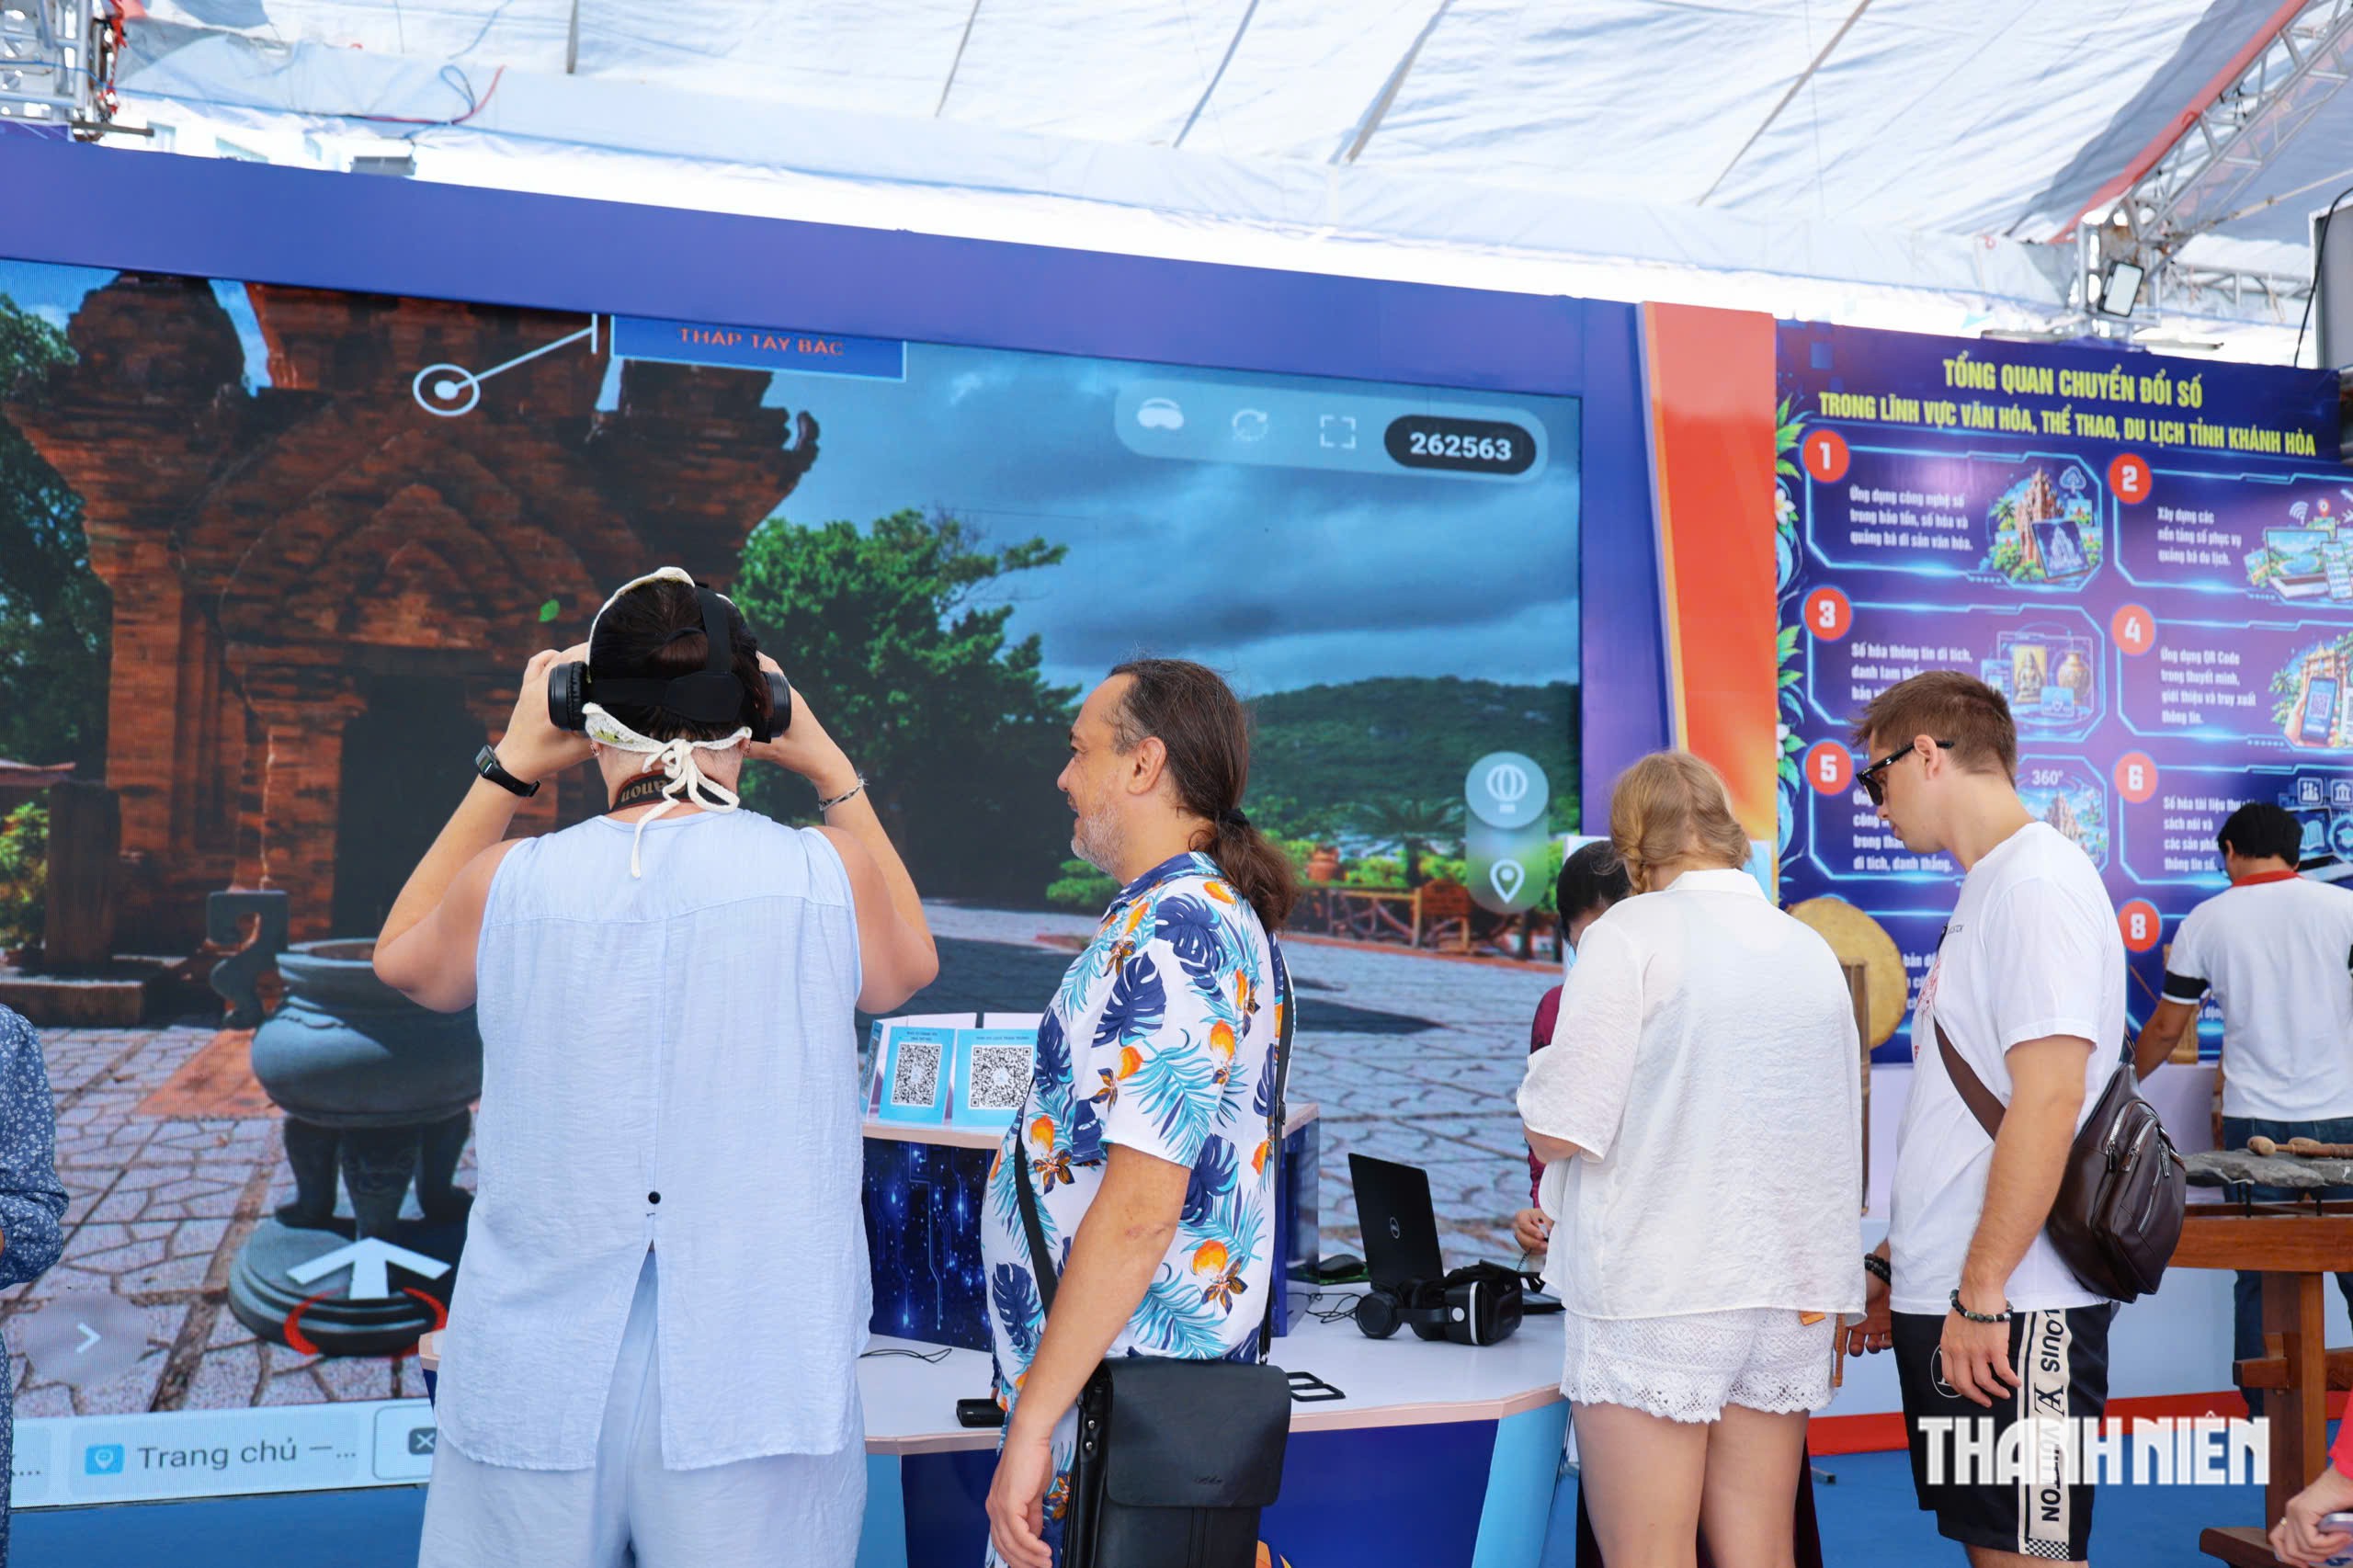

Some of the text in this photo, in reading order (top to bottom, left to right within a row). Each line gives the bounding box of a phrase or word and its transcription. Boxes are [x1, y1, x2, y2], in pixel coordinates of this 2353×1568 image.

[1943, 349, 2203, 408] TỔNG QUAN CHUYỂN ĐỔI SỐ
[1818, 392, 2316, 456] TRONG LĨNH VỰC VĂN HÓA, THỂ THAO, DU LỊCH TỈNH KHÁNH HÒA
[1410, 431, 1517, 461] 262563
[1819, 442, 1831, 470] 1
[2122, 465, 2139, 493] 2
[1849, 508, 1878, 526] trong
[1818, 600, 1836, 628] 3
[2125, 617, 2141, 643] 4
[2202, 650, 2216, 665] QR
[2217, 651, 2240, 665] Code
[1851, 664, 1879, 679] danh
[1880, 665, 1901, 680] lam
[1820, 754, 1837, 782] 5
[2127, 764, 2143, 790] 6
[621, 779, 687, 802] anon
[1853, 812, 1880, 829] công
[1853, 834, 1881, 850] trong
[1853, 855, 1865, 870] di
[1893, 856, 1919, 870] danh
[2131, 913, 2146, 939] 8
[137, 1446, 229, 1471] Trang
[241, 1437, 297, 1463] chủ
